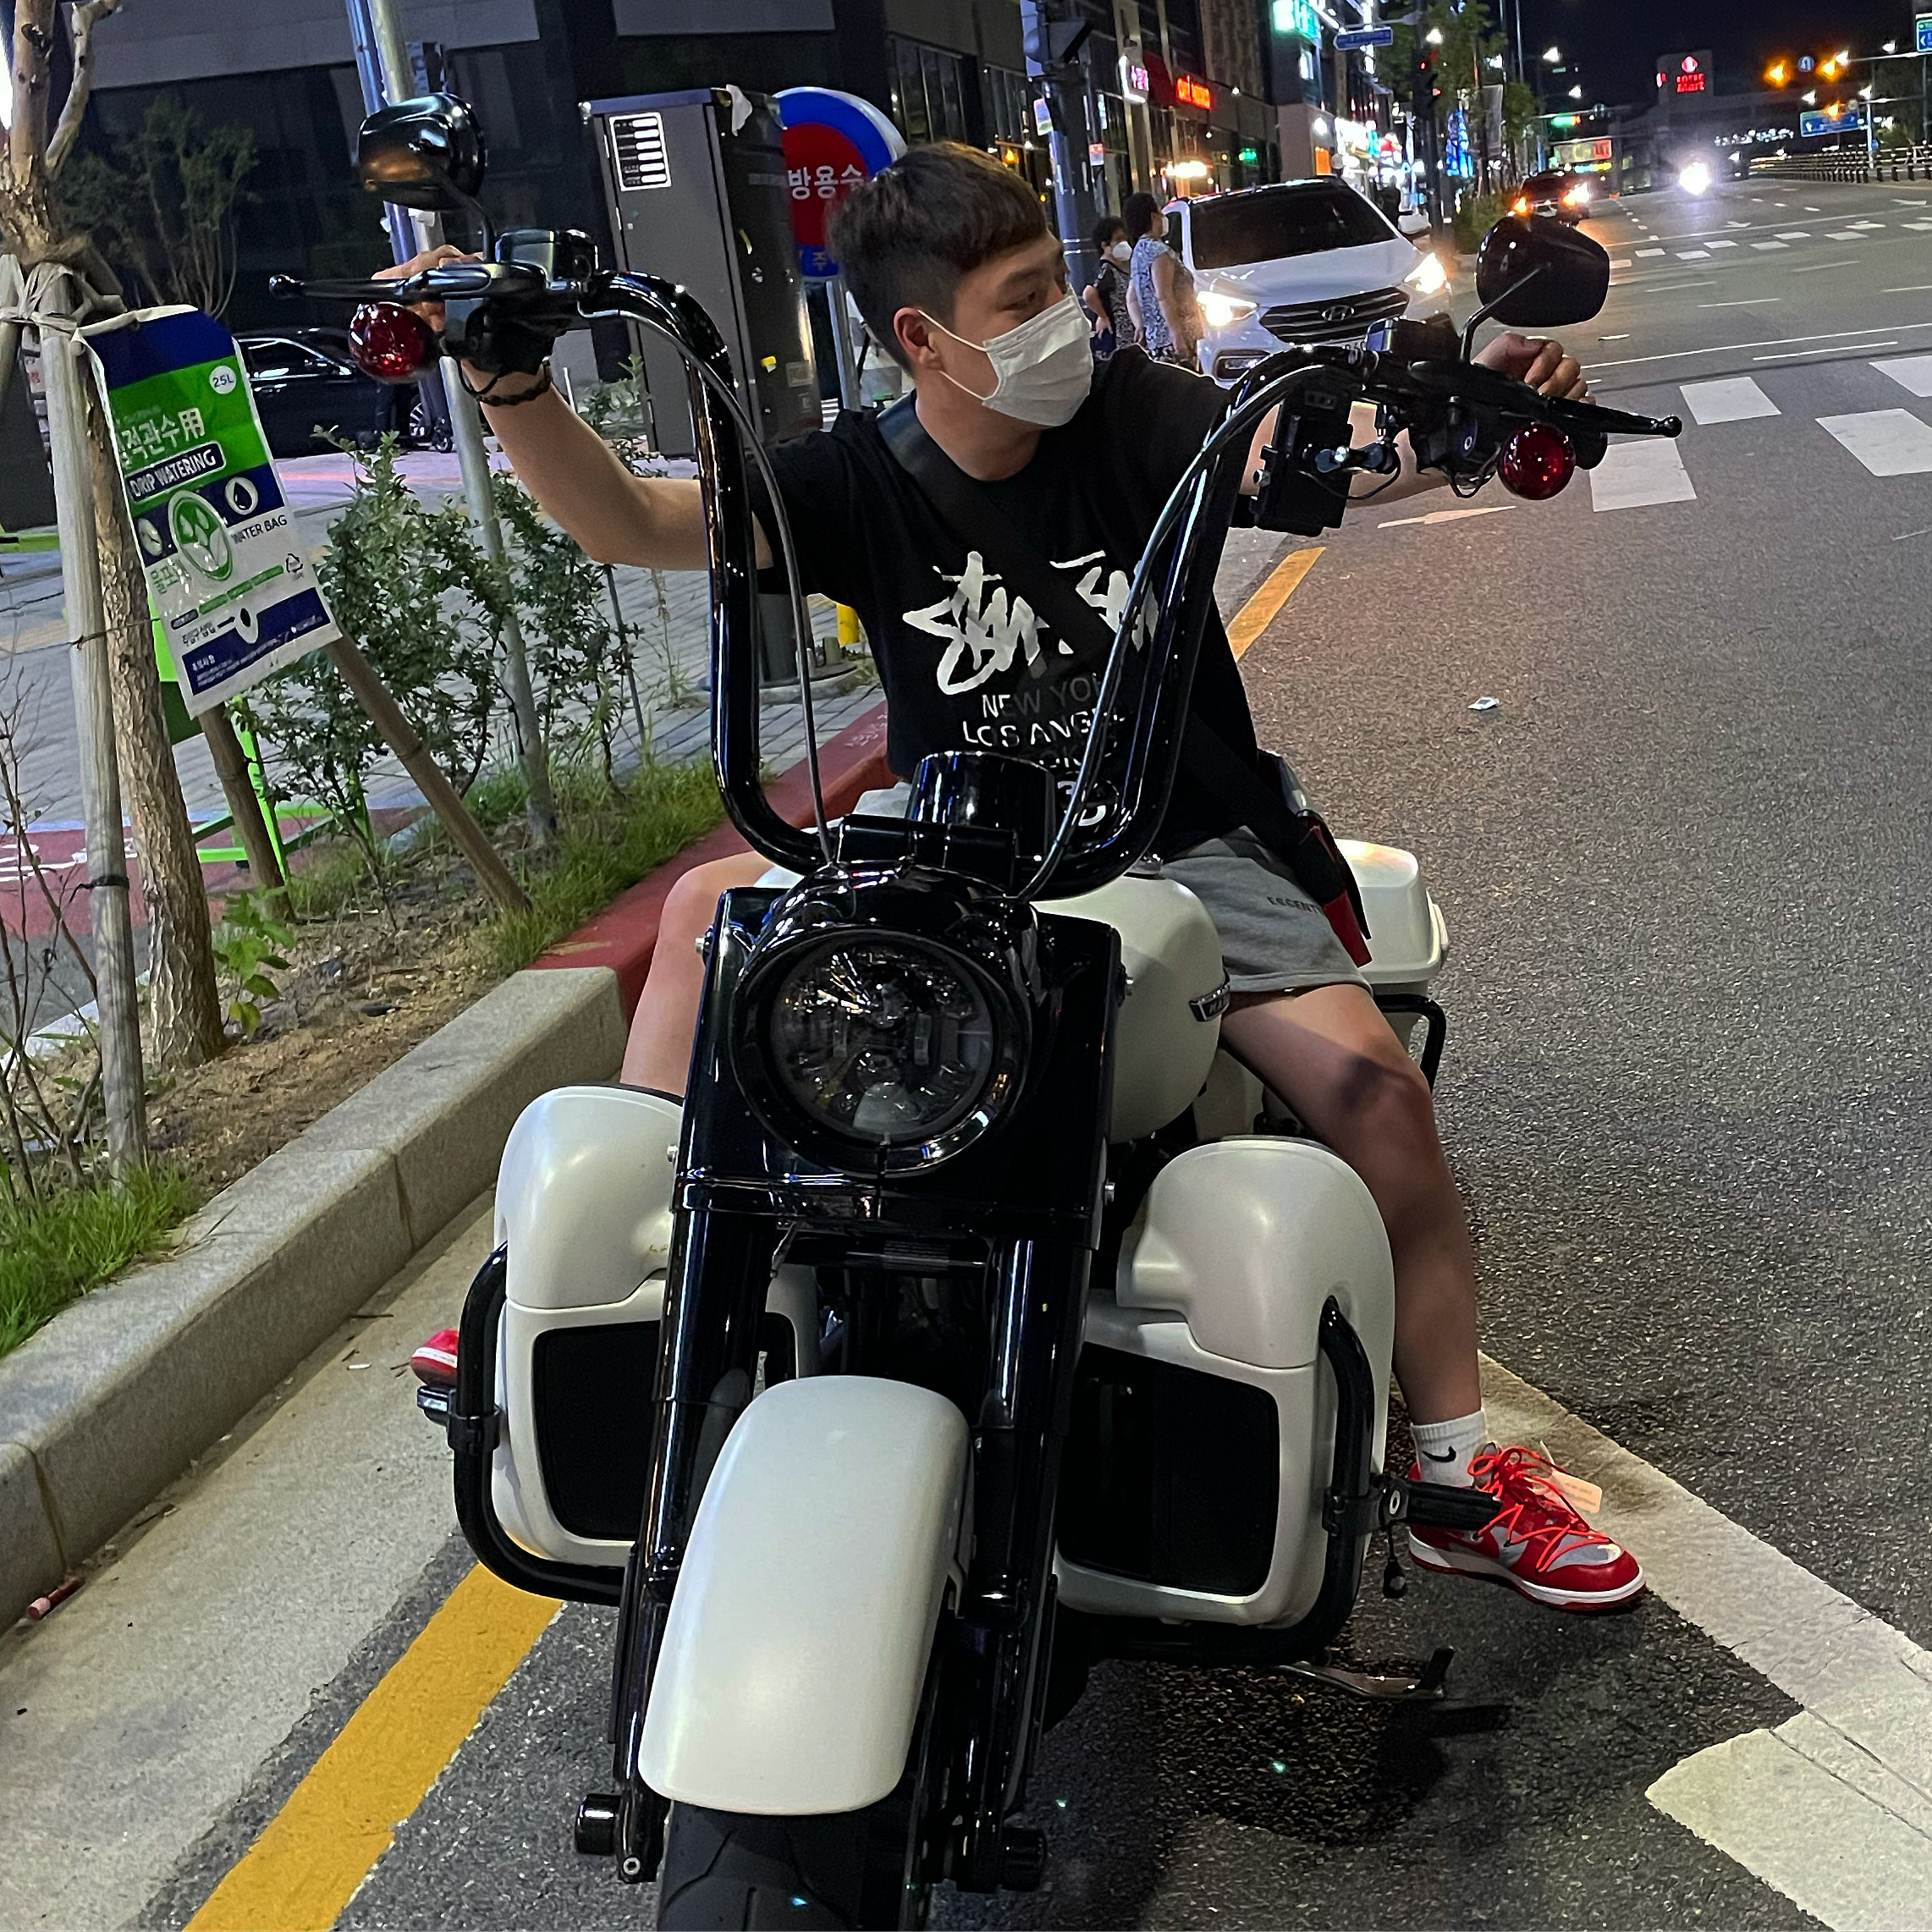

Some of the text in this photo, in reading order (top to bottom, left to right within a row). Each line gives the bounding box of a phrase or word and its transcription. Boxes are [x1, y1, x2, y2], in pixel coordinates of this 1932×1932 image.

[212, 374, 234, 388] 25L
[129, 449, 217, 497] DRIP WATERING
[230, 514, 288, 544] WATER BAG
[982, 673, 1101, 719] NEW YO
[962, 720, 1019, 748] LOS
